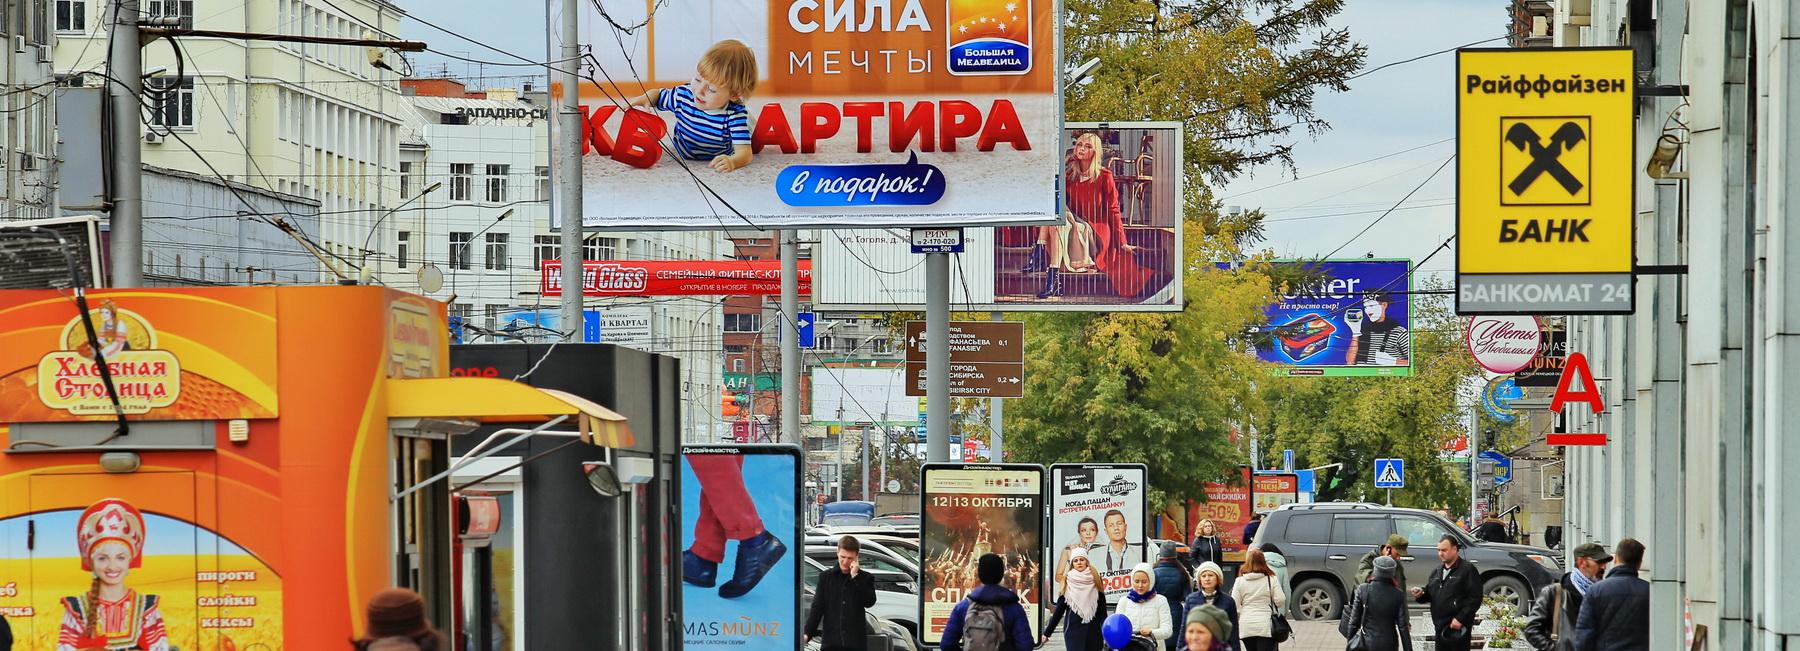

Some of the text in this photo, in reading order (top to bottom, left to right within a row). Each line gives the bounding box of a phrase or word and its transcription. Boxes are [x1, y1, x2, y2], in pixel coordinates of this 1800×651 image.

[788, 0, 932, 33] СИЛА
[789, 50, 932, 75] МЕЧТЫ
[1466, 74, 1626, 98] Райффайзен
[790, 168, 934, 202] в подарок!
[925, 230, 948, 238] РИМ
[1499, 219, 1592, 243] БАНК
[600, 267, 644, 289] Class
[656, 269, 716, 279] СЕМЕЙНЫЙ
[1460, 283, 1630, 303] БАНКОМАТ 24
[1292, 303, 1320, 311] просто
[1321, 302, 1340, 310] сыр!
[972, 498, 1032, 508] ОКТЯБРЯ
